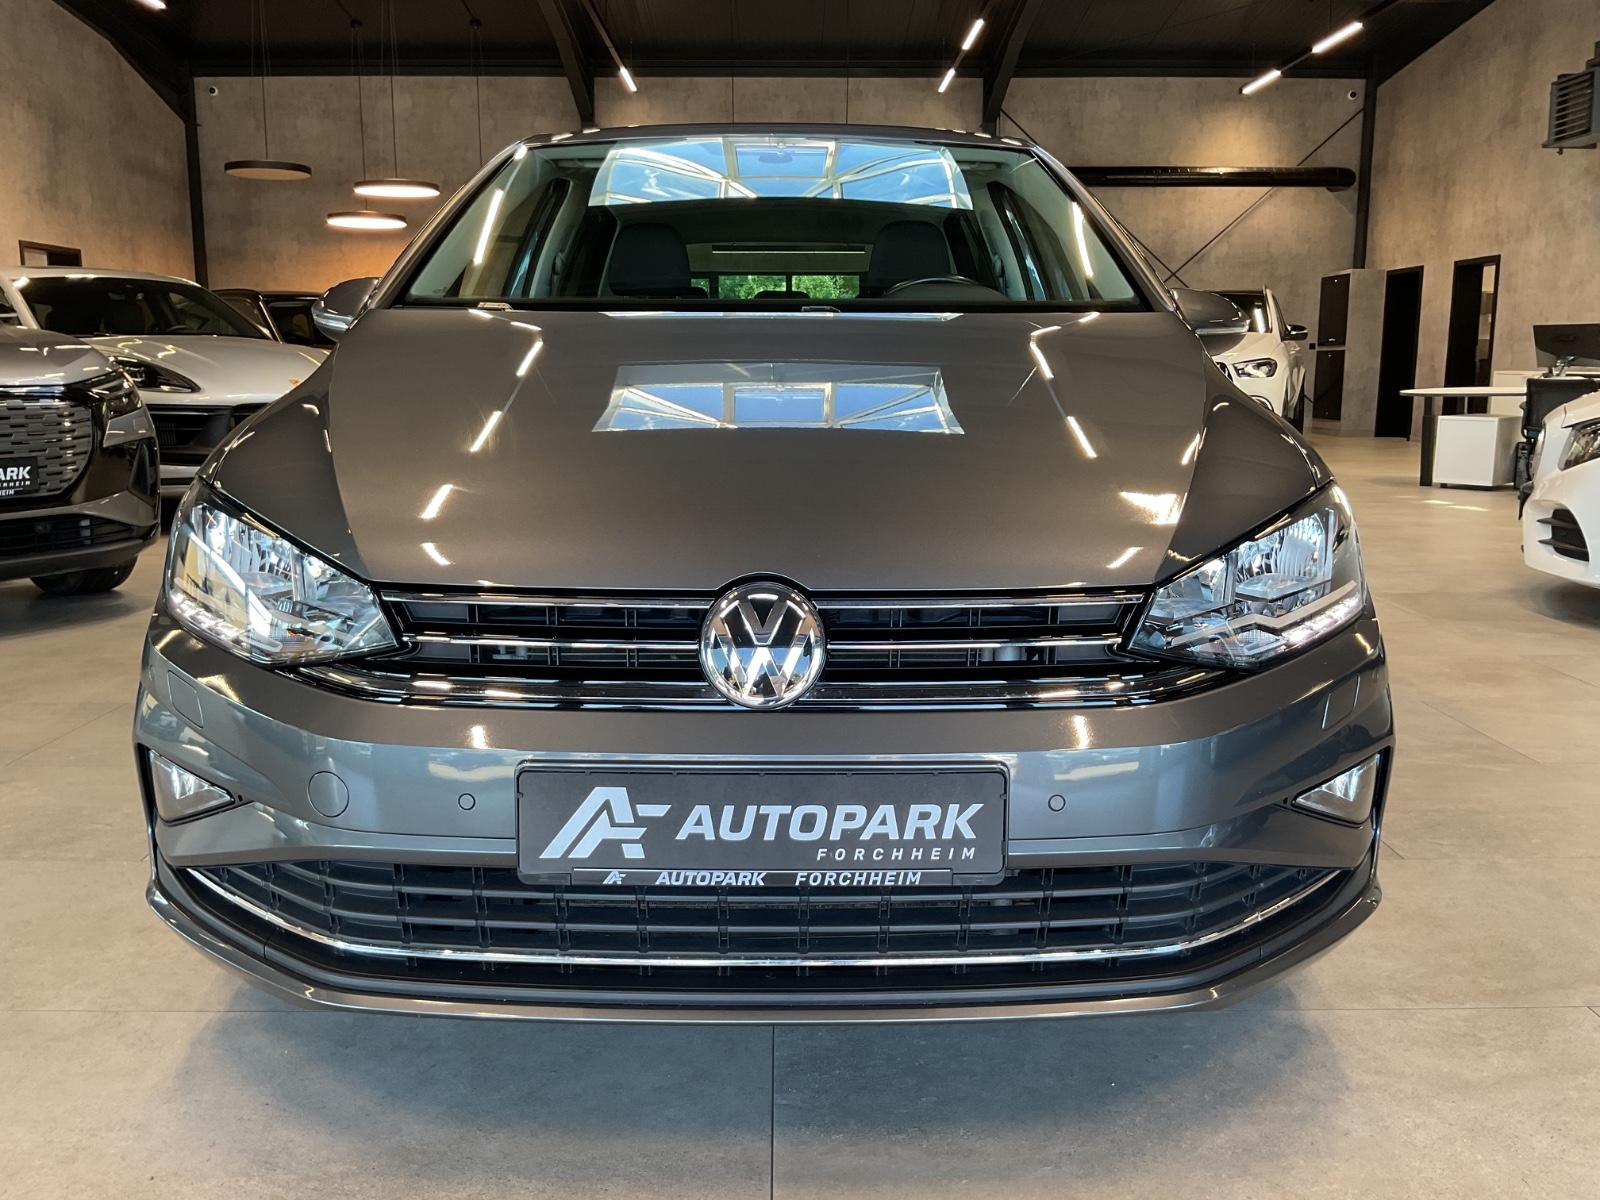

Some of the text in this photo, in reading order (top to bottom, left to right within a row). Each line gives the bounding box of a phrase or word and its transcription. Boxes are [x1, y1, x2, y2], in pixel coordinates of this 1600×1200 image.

[706, 592, 820, 702] VW
[674, 803, 985, 842] AUTOPARK
[816, 847, 976, 861] FORCHHEIM
[655, 871, 767, 886] AUTOPARK
[795, 871, 922, 886] FORCHHEIM
